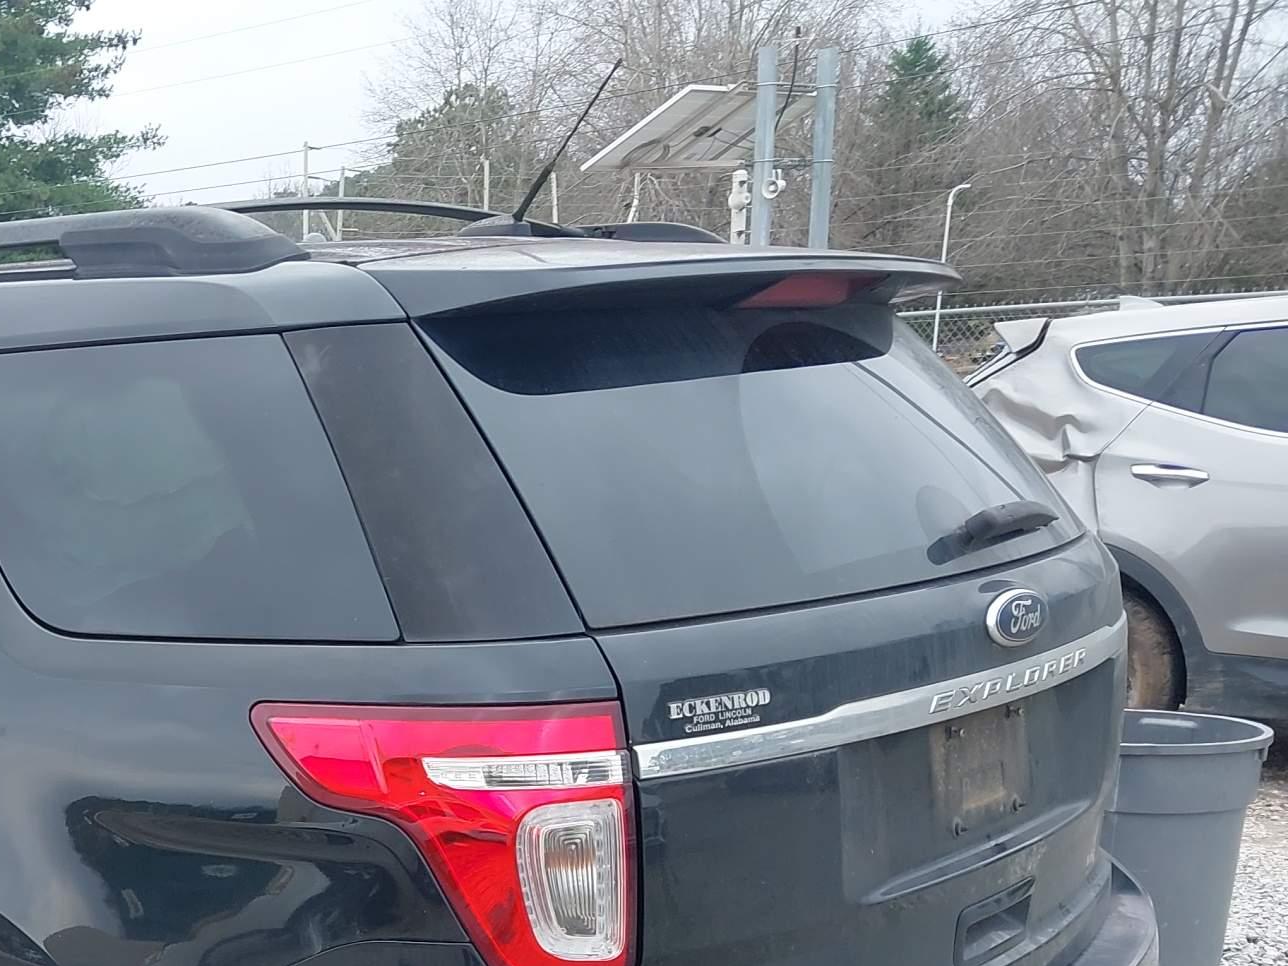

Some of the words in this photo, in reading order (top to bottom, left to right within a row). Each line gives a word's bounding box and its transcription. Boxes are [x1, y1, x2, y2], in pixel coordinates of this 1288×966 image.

[1010, 599, 1041, 633] Ford
[928, 648, 1087, 714] EXPLORER
[668, 688, 771, 719] ECKENROD
[693, 714, 716, 724] FORD
[718, 708, 753, 720] LINCOLN
[685, 721, 724, 733] Cullman,
[725, 715, 761, 727] Alabama
